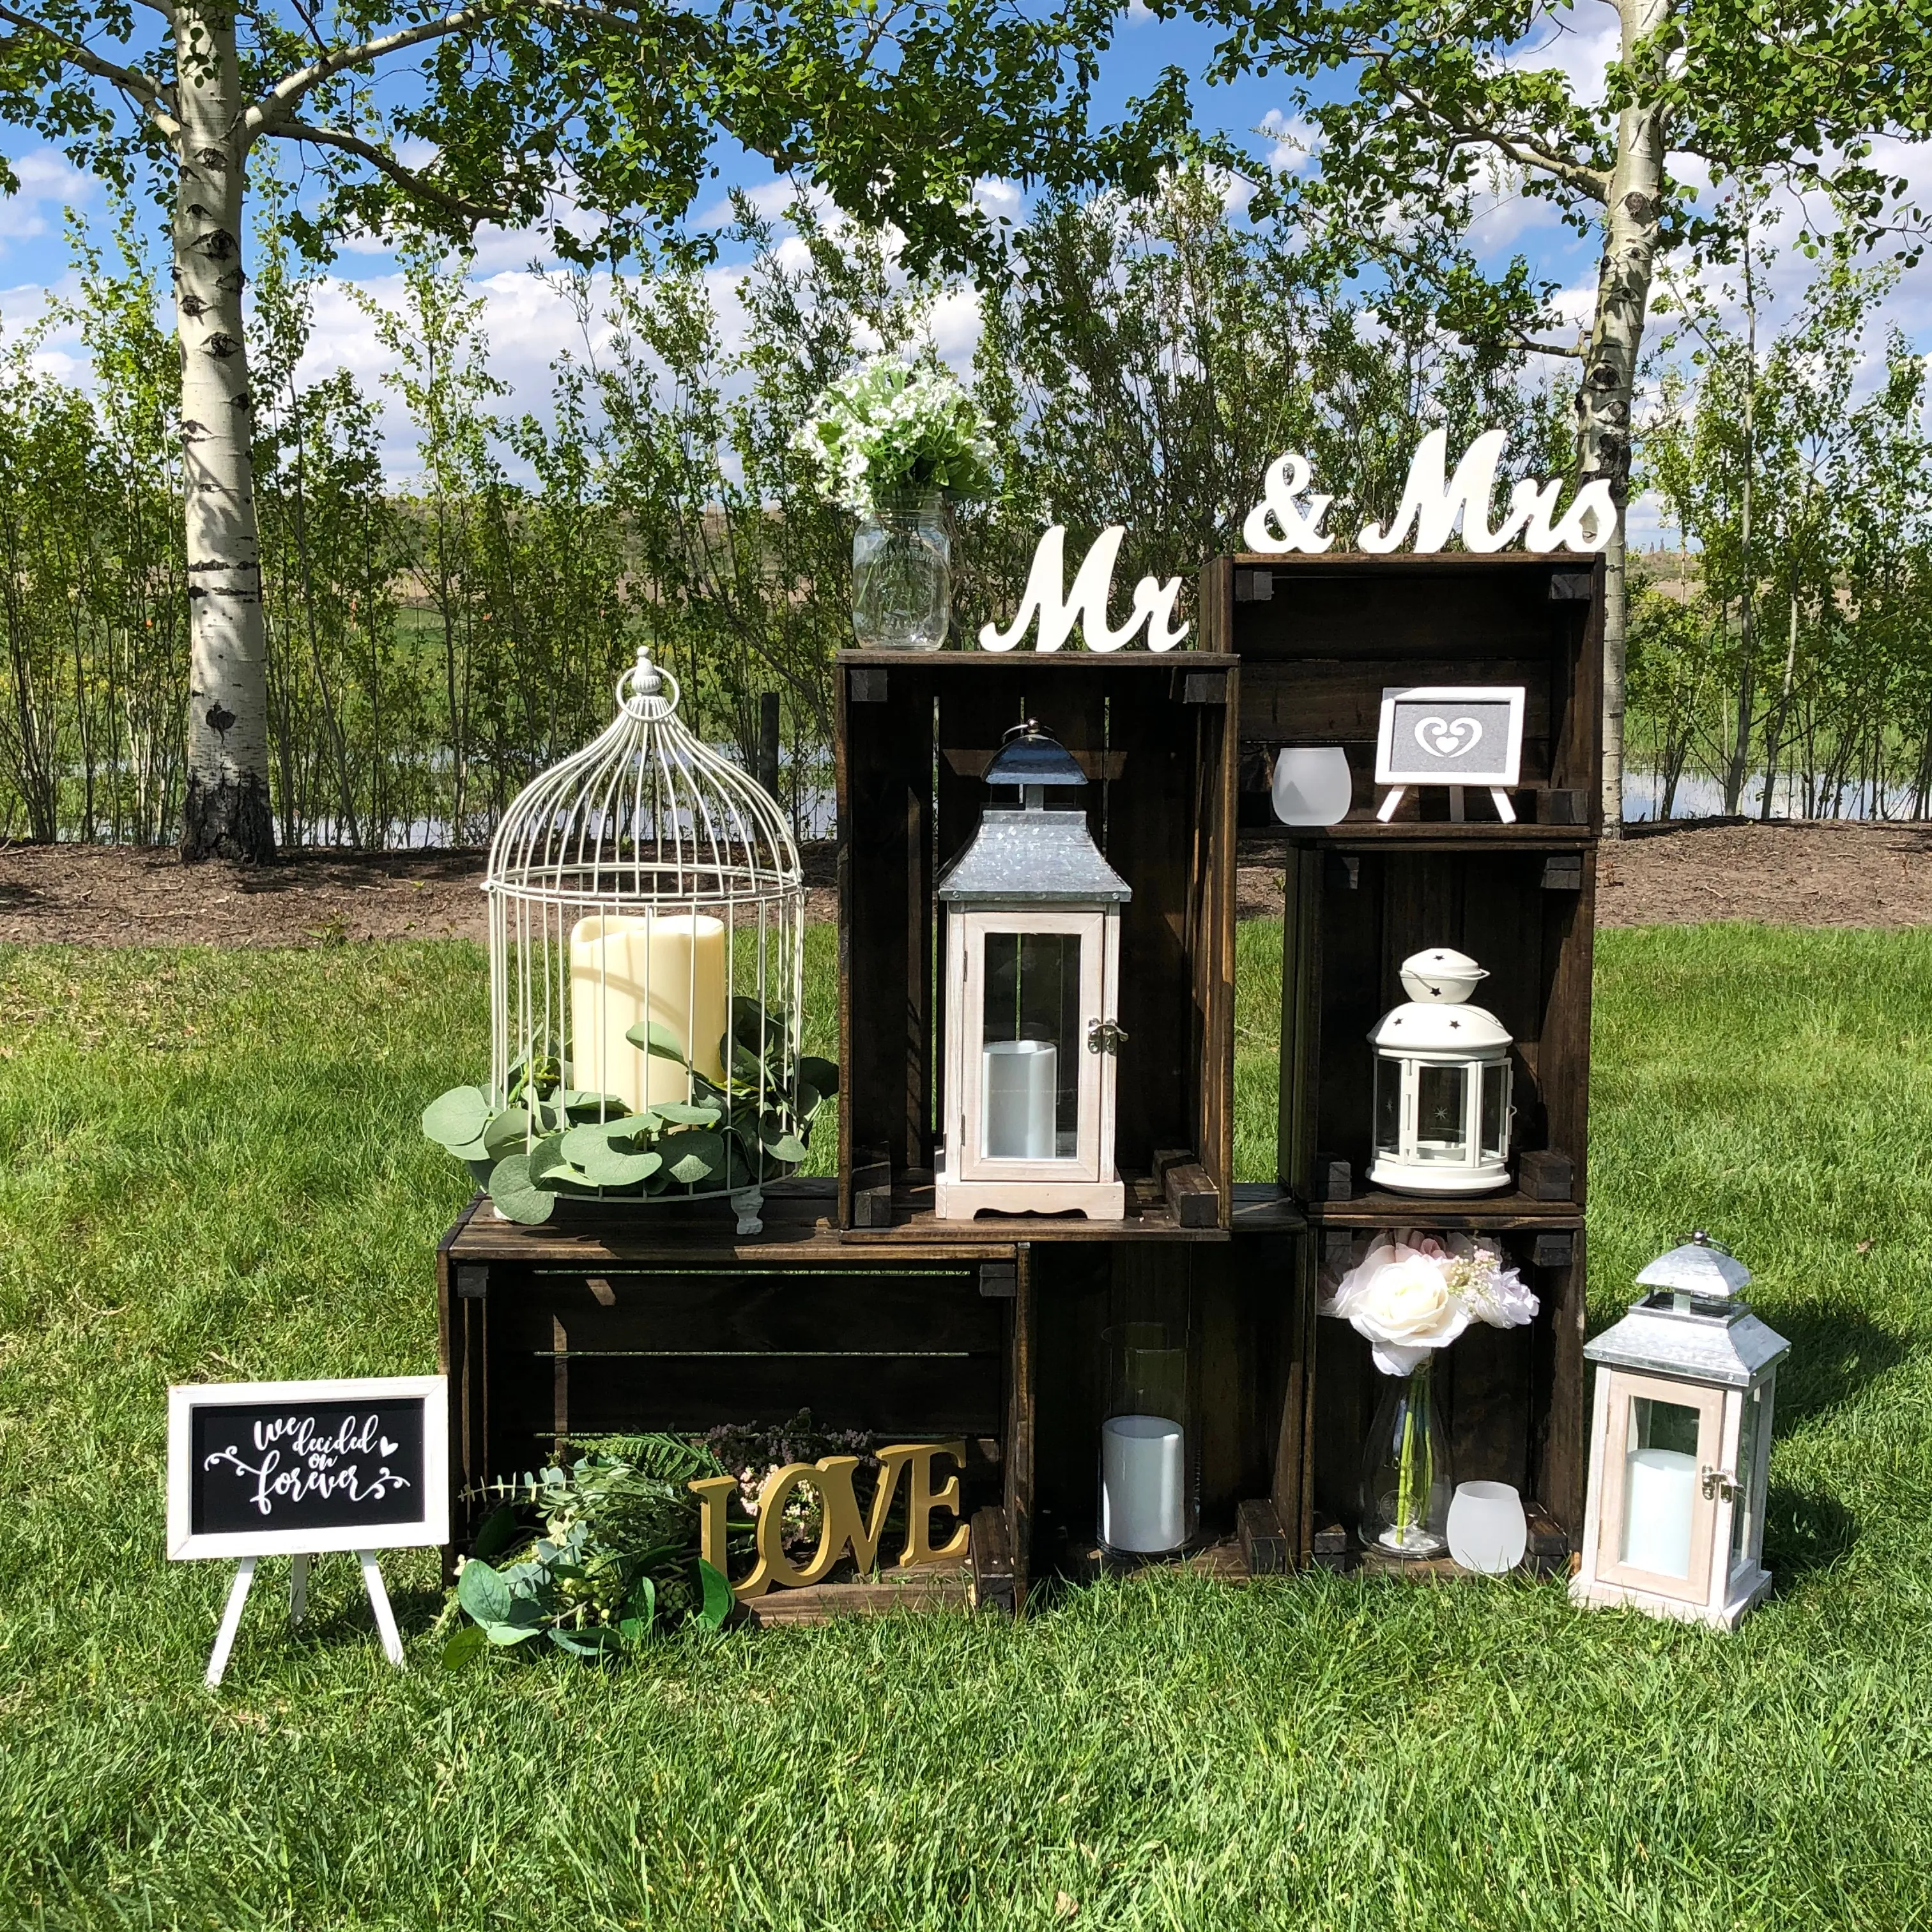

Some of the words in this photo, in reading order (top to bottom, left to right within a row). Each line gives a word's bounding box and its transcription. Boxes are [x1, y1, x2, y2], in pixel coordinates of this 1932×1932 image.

[979, 525, 1190, 652] Mr
[1243, 453, 1335, 553] &
[1358, 429, 1618, 553] Mrs
[292, 1414, 378, 1456] decided
[308, 1452, 339, 1471] on
[249, 1450, 367, 1515] forever
[687, 1441, 970, 1600] LOVE
